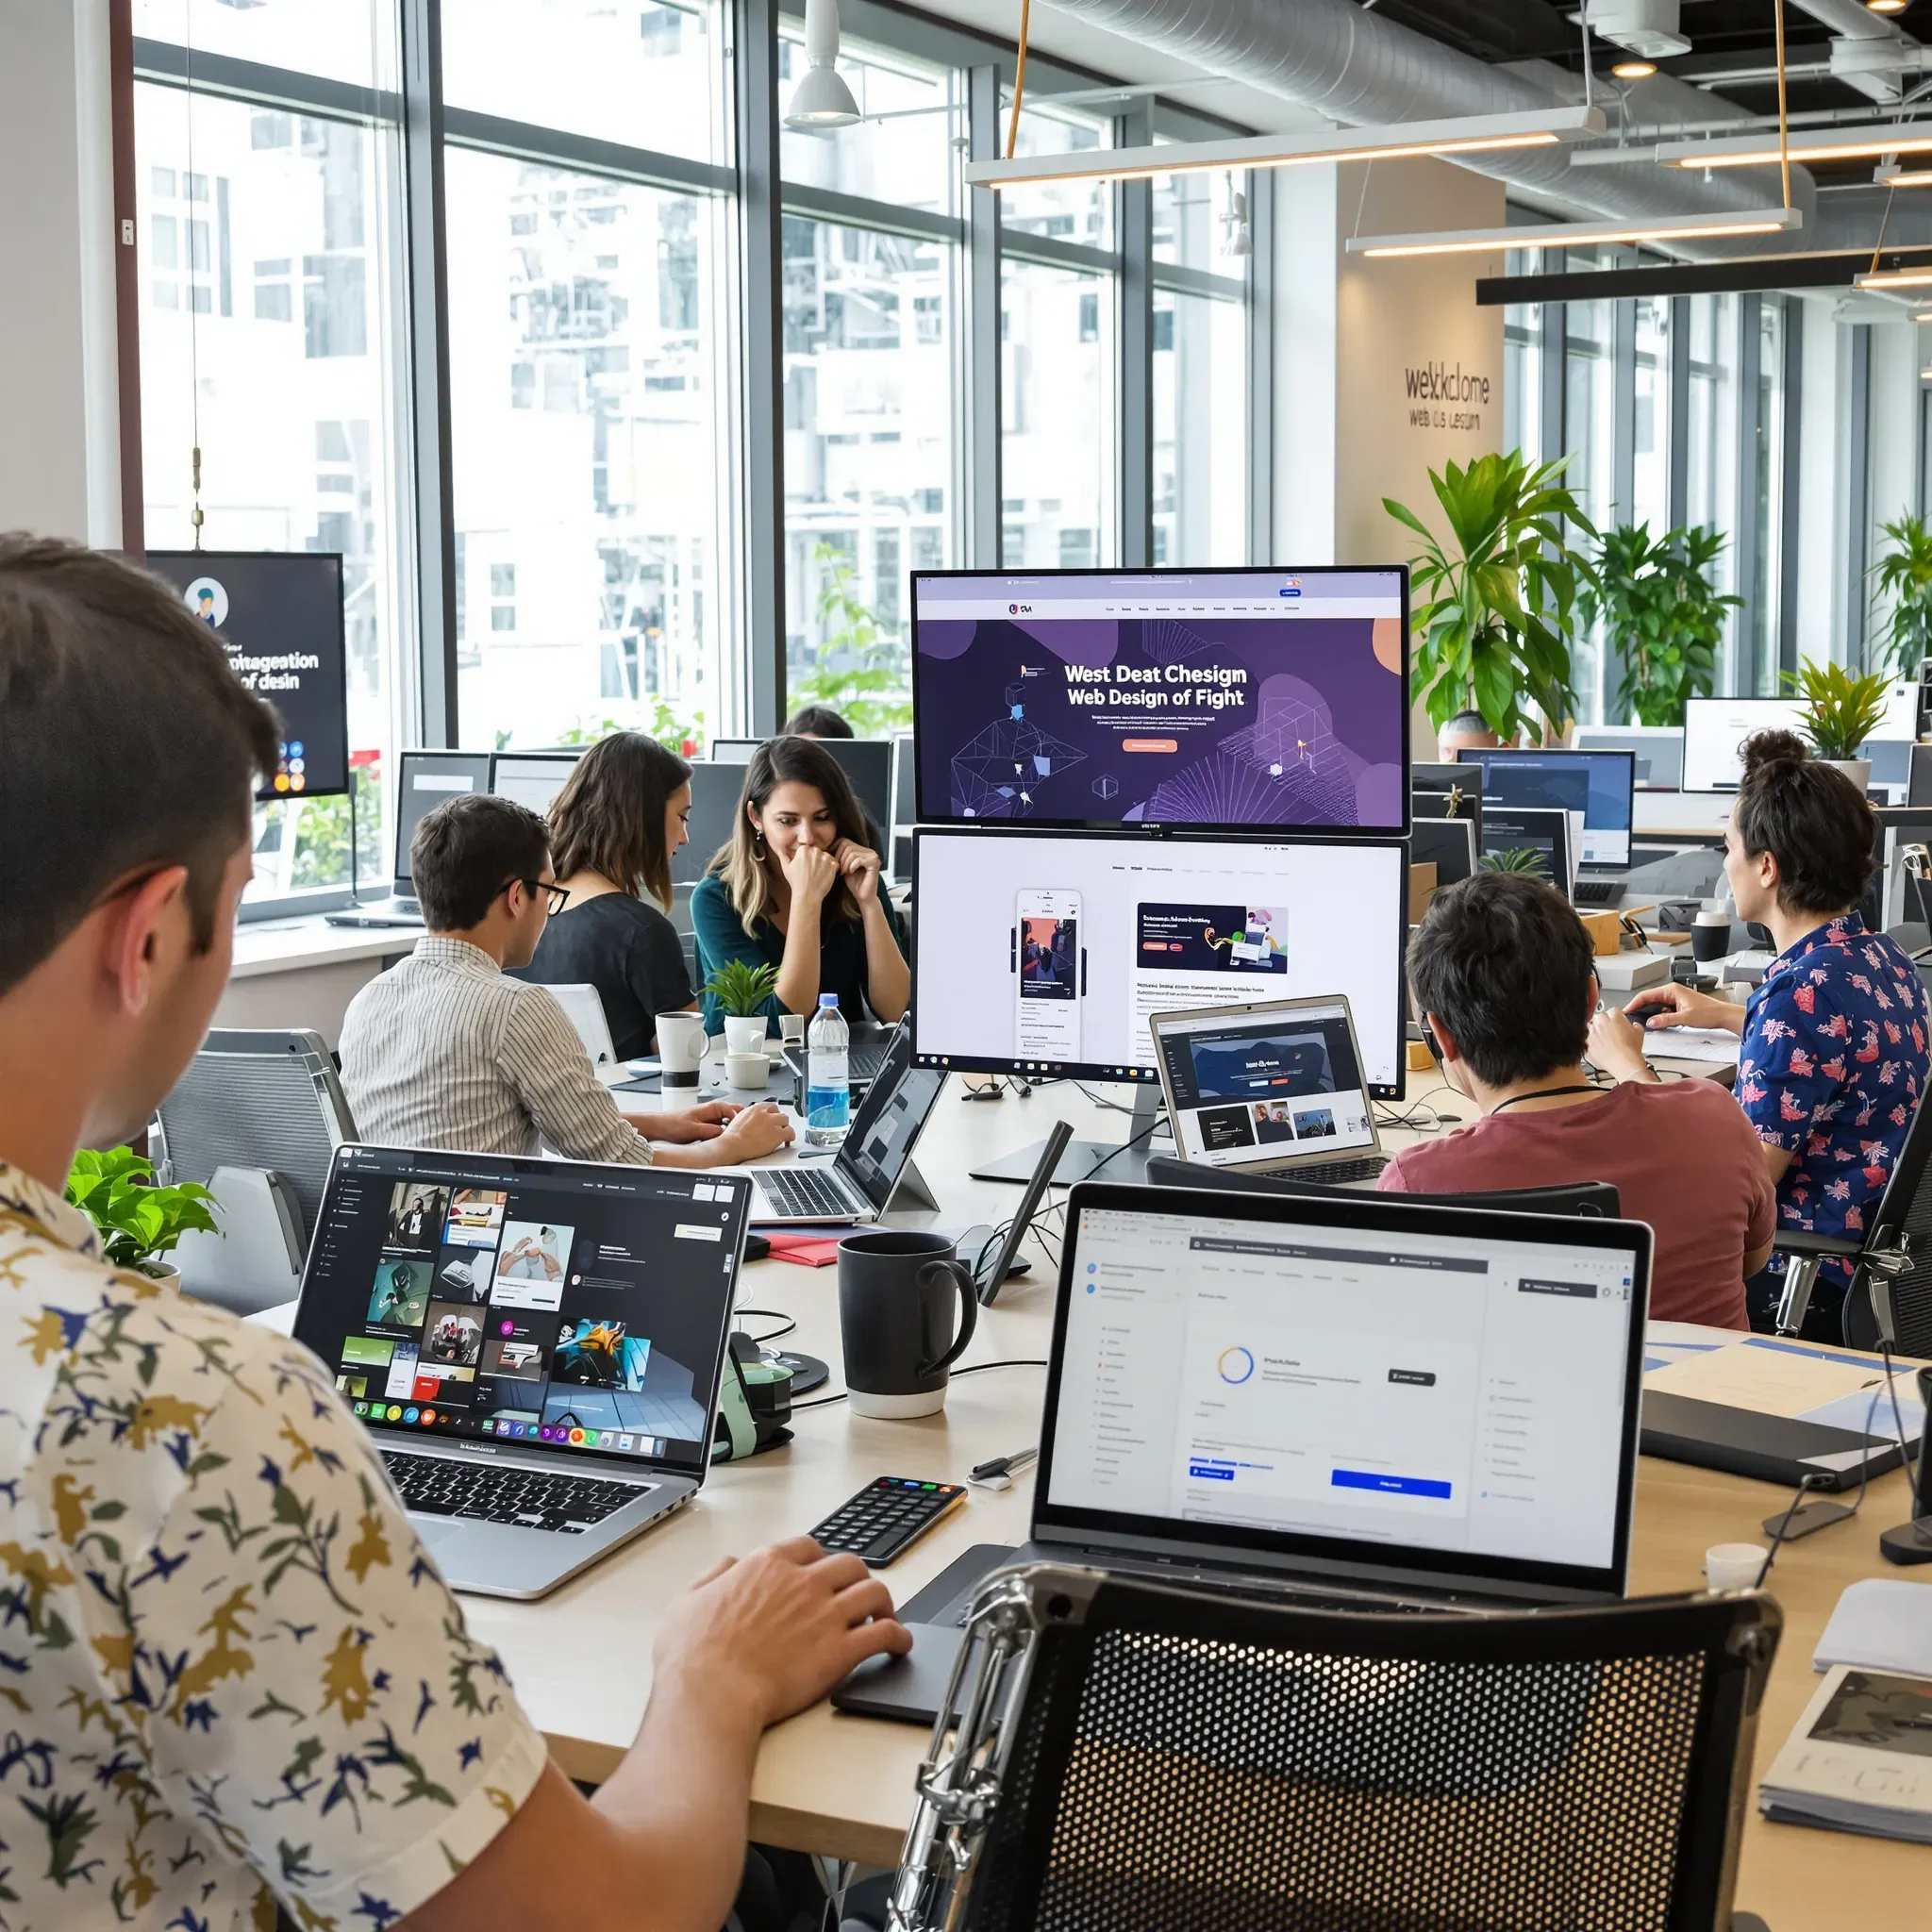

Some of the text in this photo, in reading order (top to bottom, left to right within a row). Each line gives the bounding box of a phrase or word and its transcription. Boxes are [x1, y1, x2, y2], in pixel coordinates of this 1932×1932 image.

[1064, 664, 1111, 683] West
[1116, 665, 1161, 683] Deat
[1067, 688, 1106, 706] Web
[1108, 689, 1168, 709] Design
[1172, 688, 1192, 706] of
